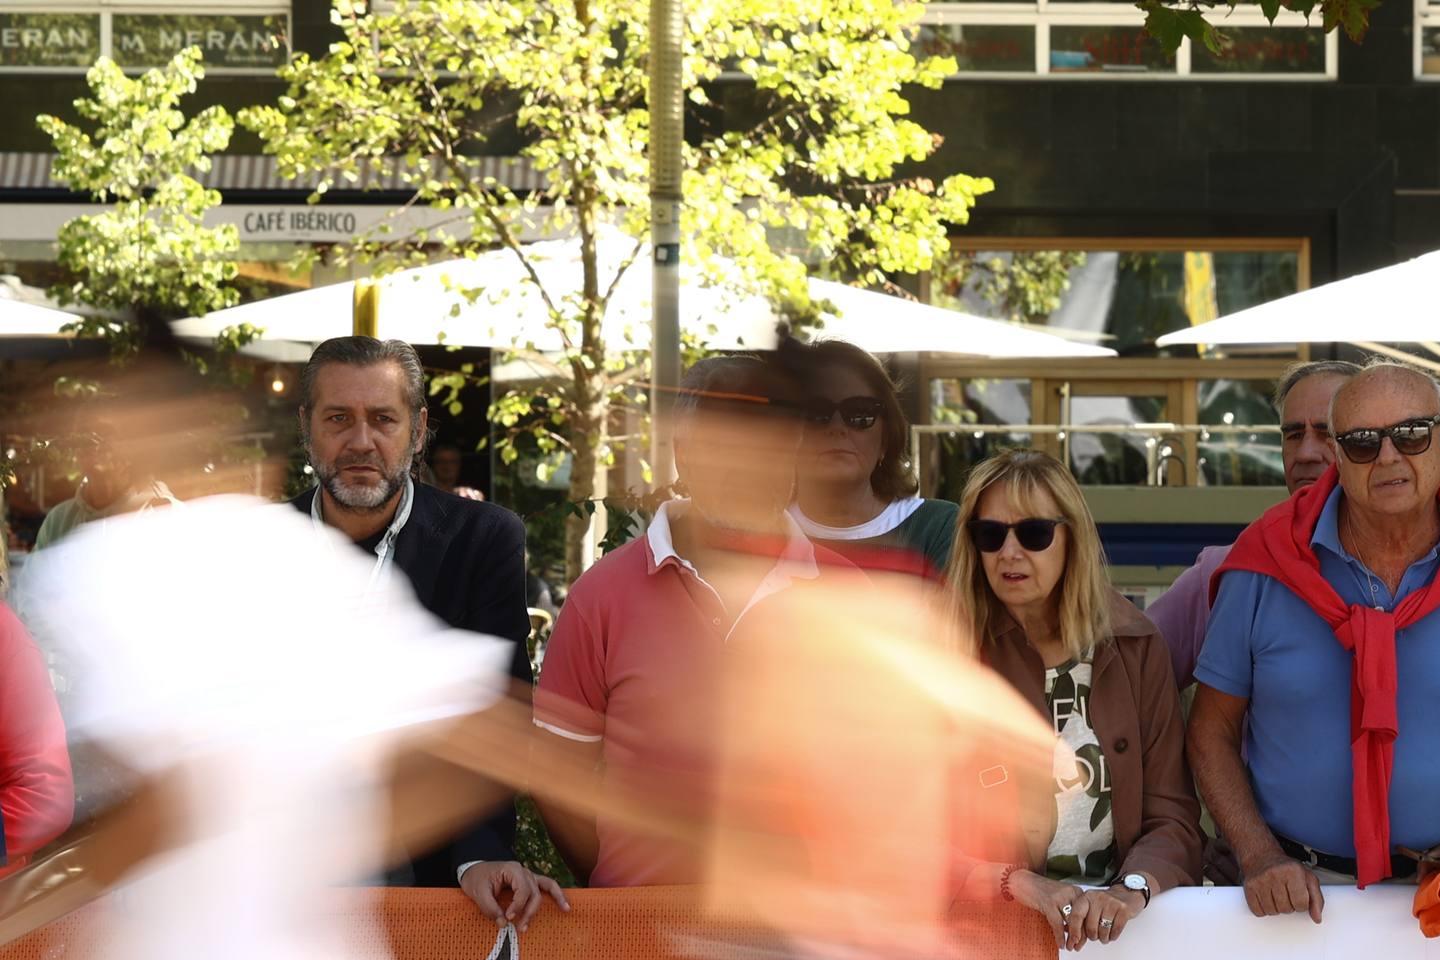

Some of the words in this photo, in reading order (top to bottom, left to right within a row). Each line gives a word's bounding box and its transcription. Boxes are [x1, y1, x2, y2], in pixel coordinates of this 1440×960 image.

[159, 29, 272, 50] MERAN
[243, 208, 286, 234] CAFÉ
[289, 208, 357, 235] IBÉRICO
